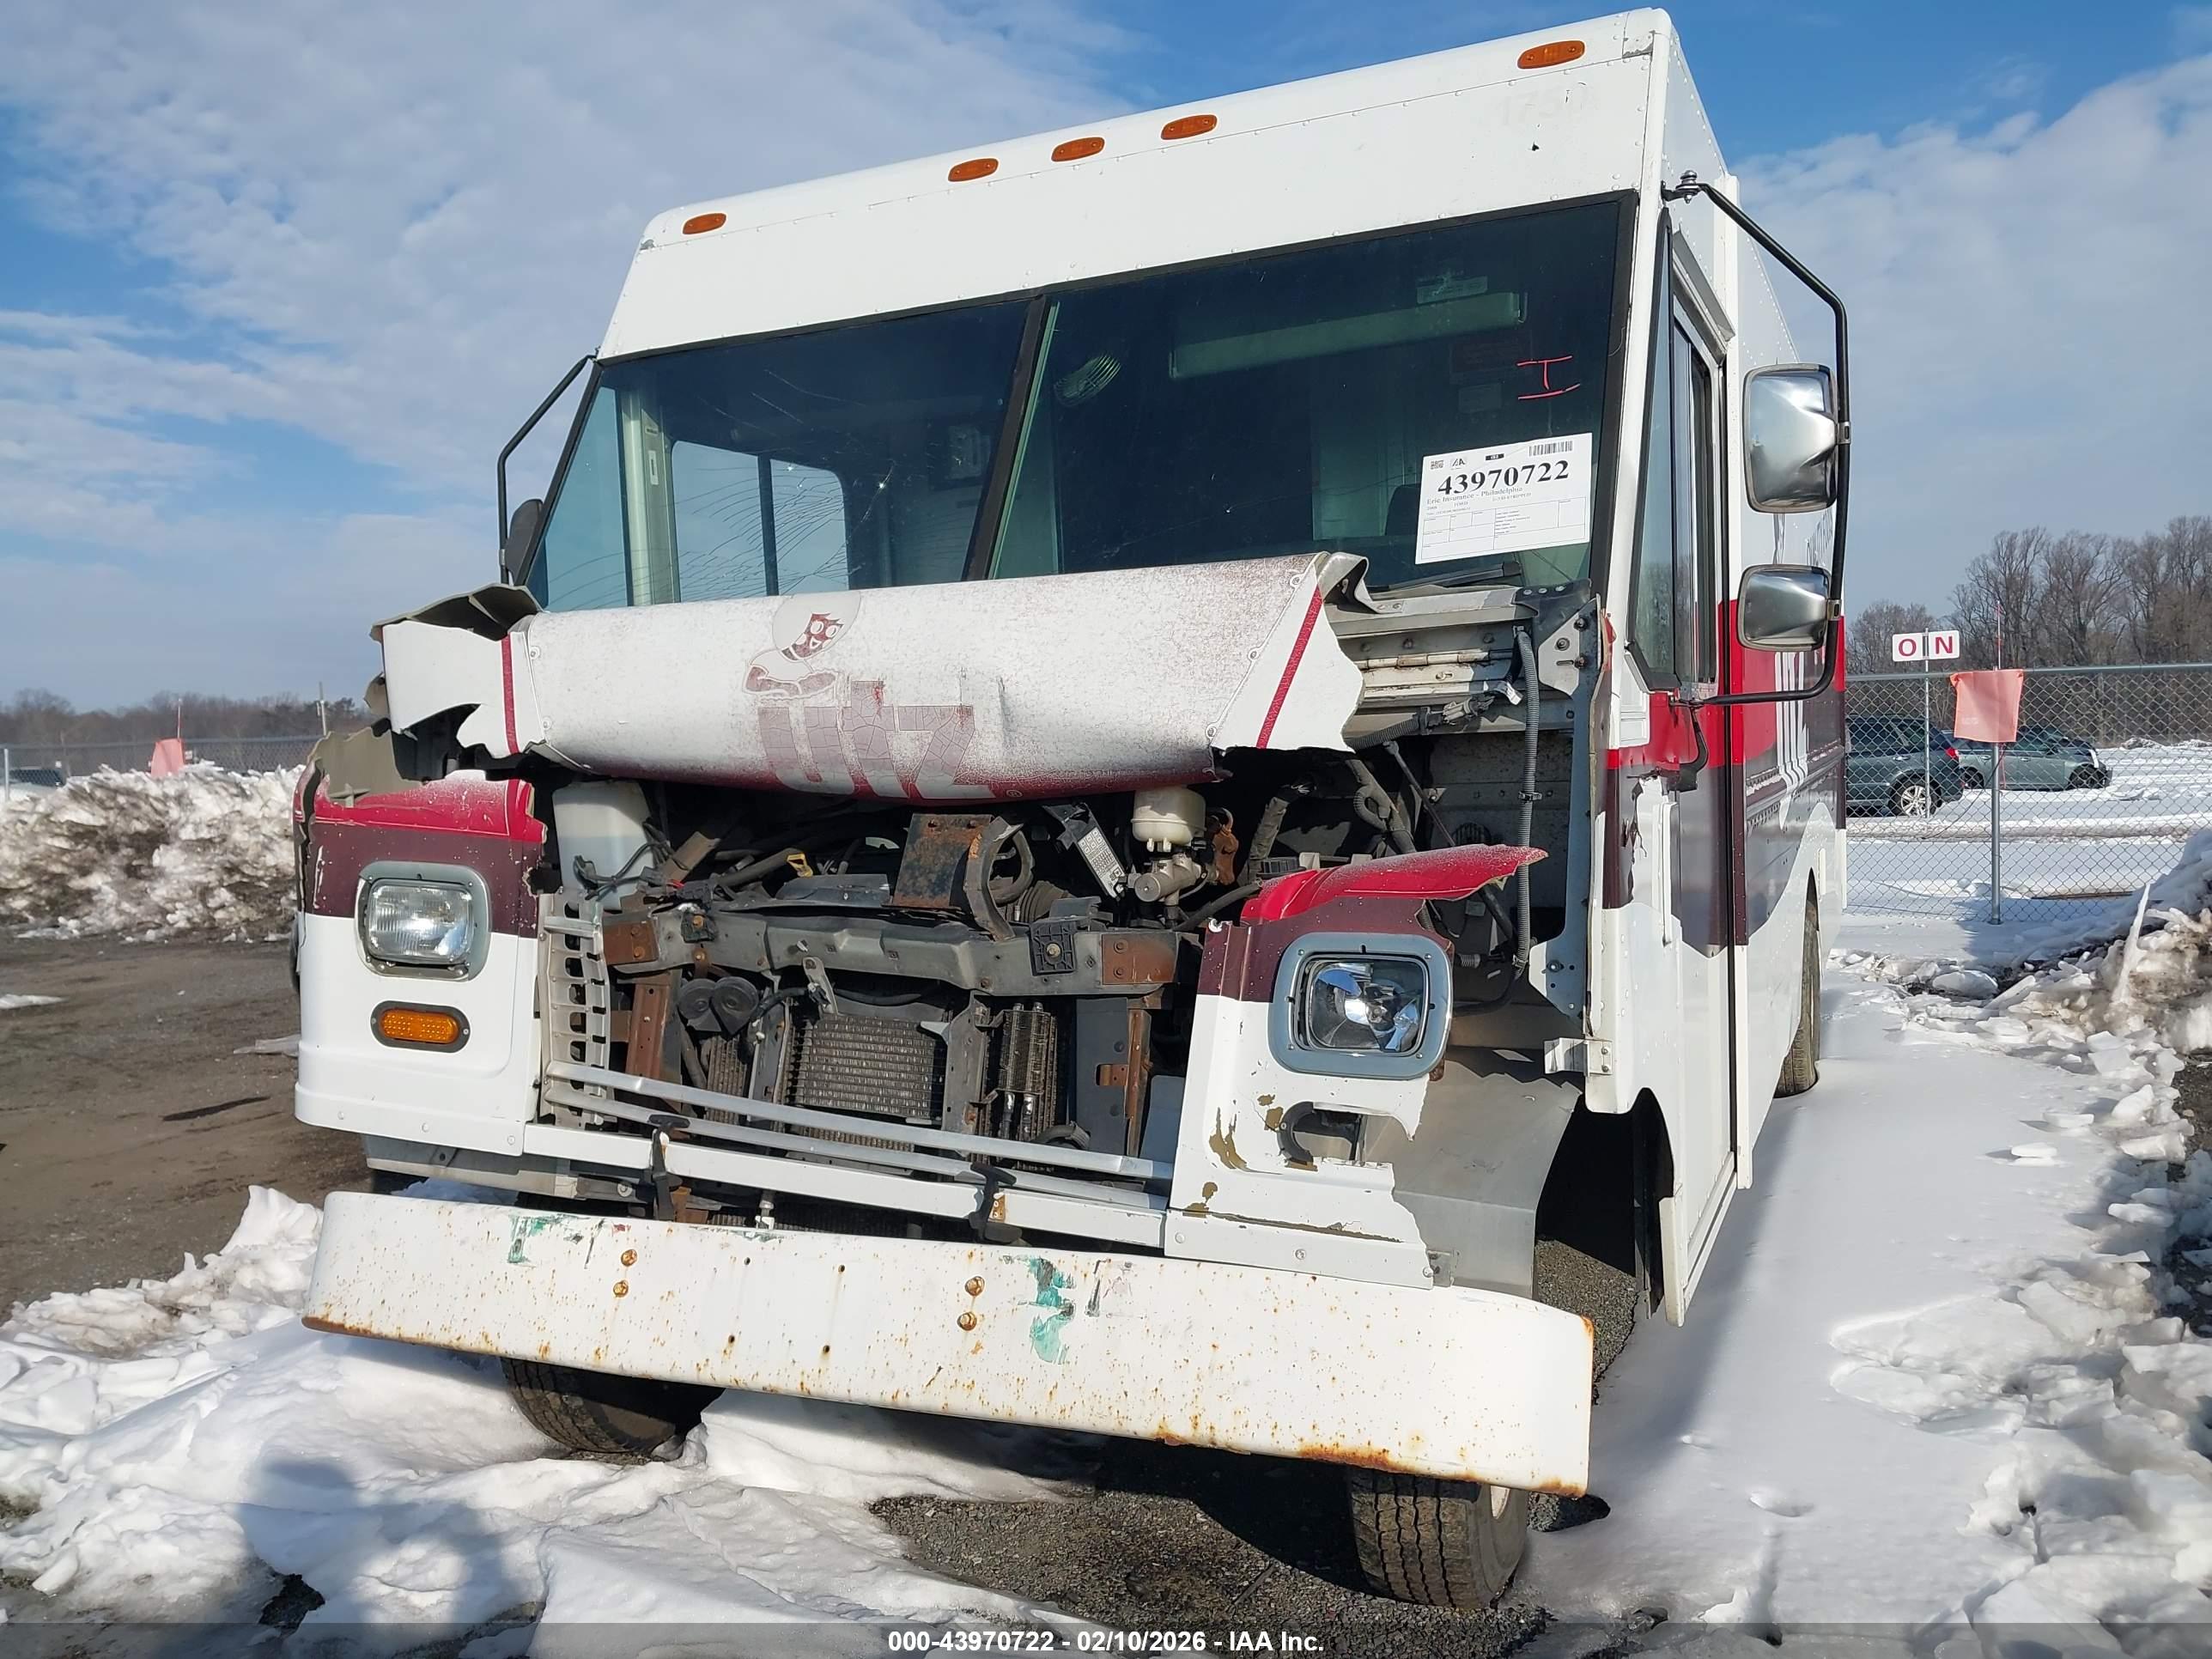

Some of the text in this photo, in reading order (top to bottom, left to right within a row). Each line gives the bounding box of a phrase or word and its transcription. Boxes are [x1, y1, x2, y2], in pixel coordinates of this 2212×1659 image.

[1437, 459, 1570, 495] 43970722
[1443, 493, 1474, 503] Insurance
[1480, 486, 1523, 497] Philadelphia
